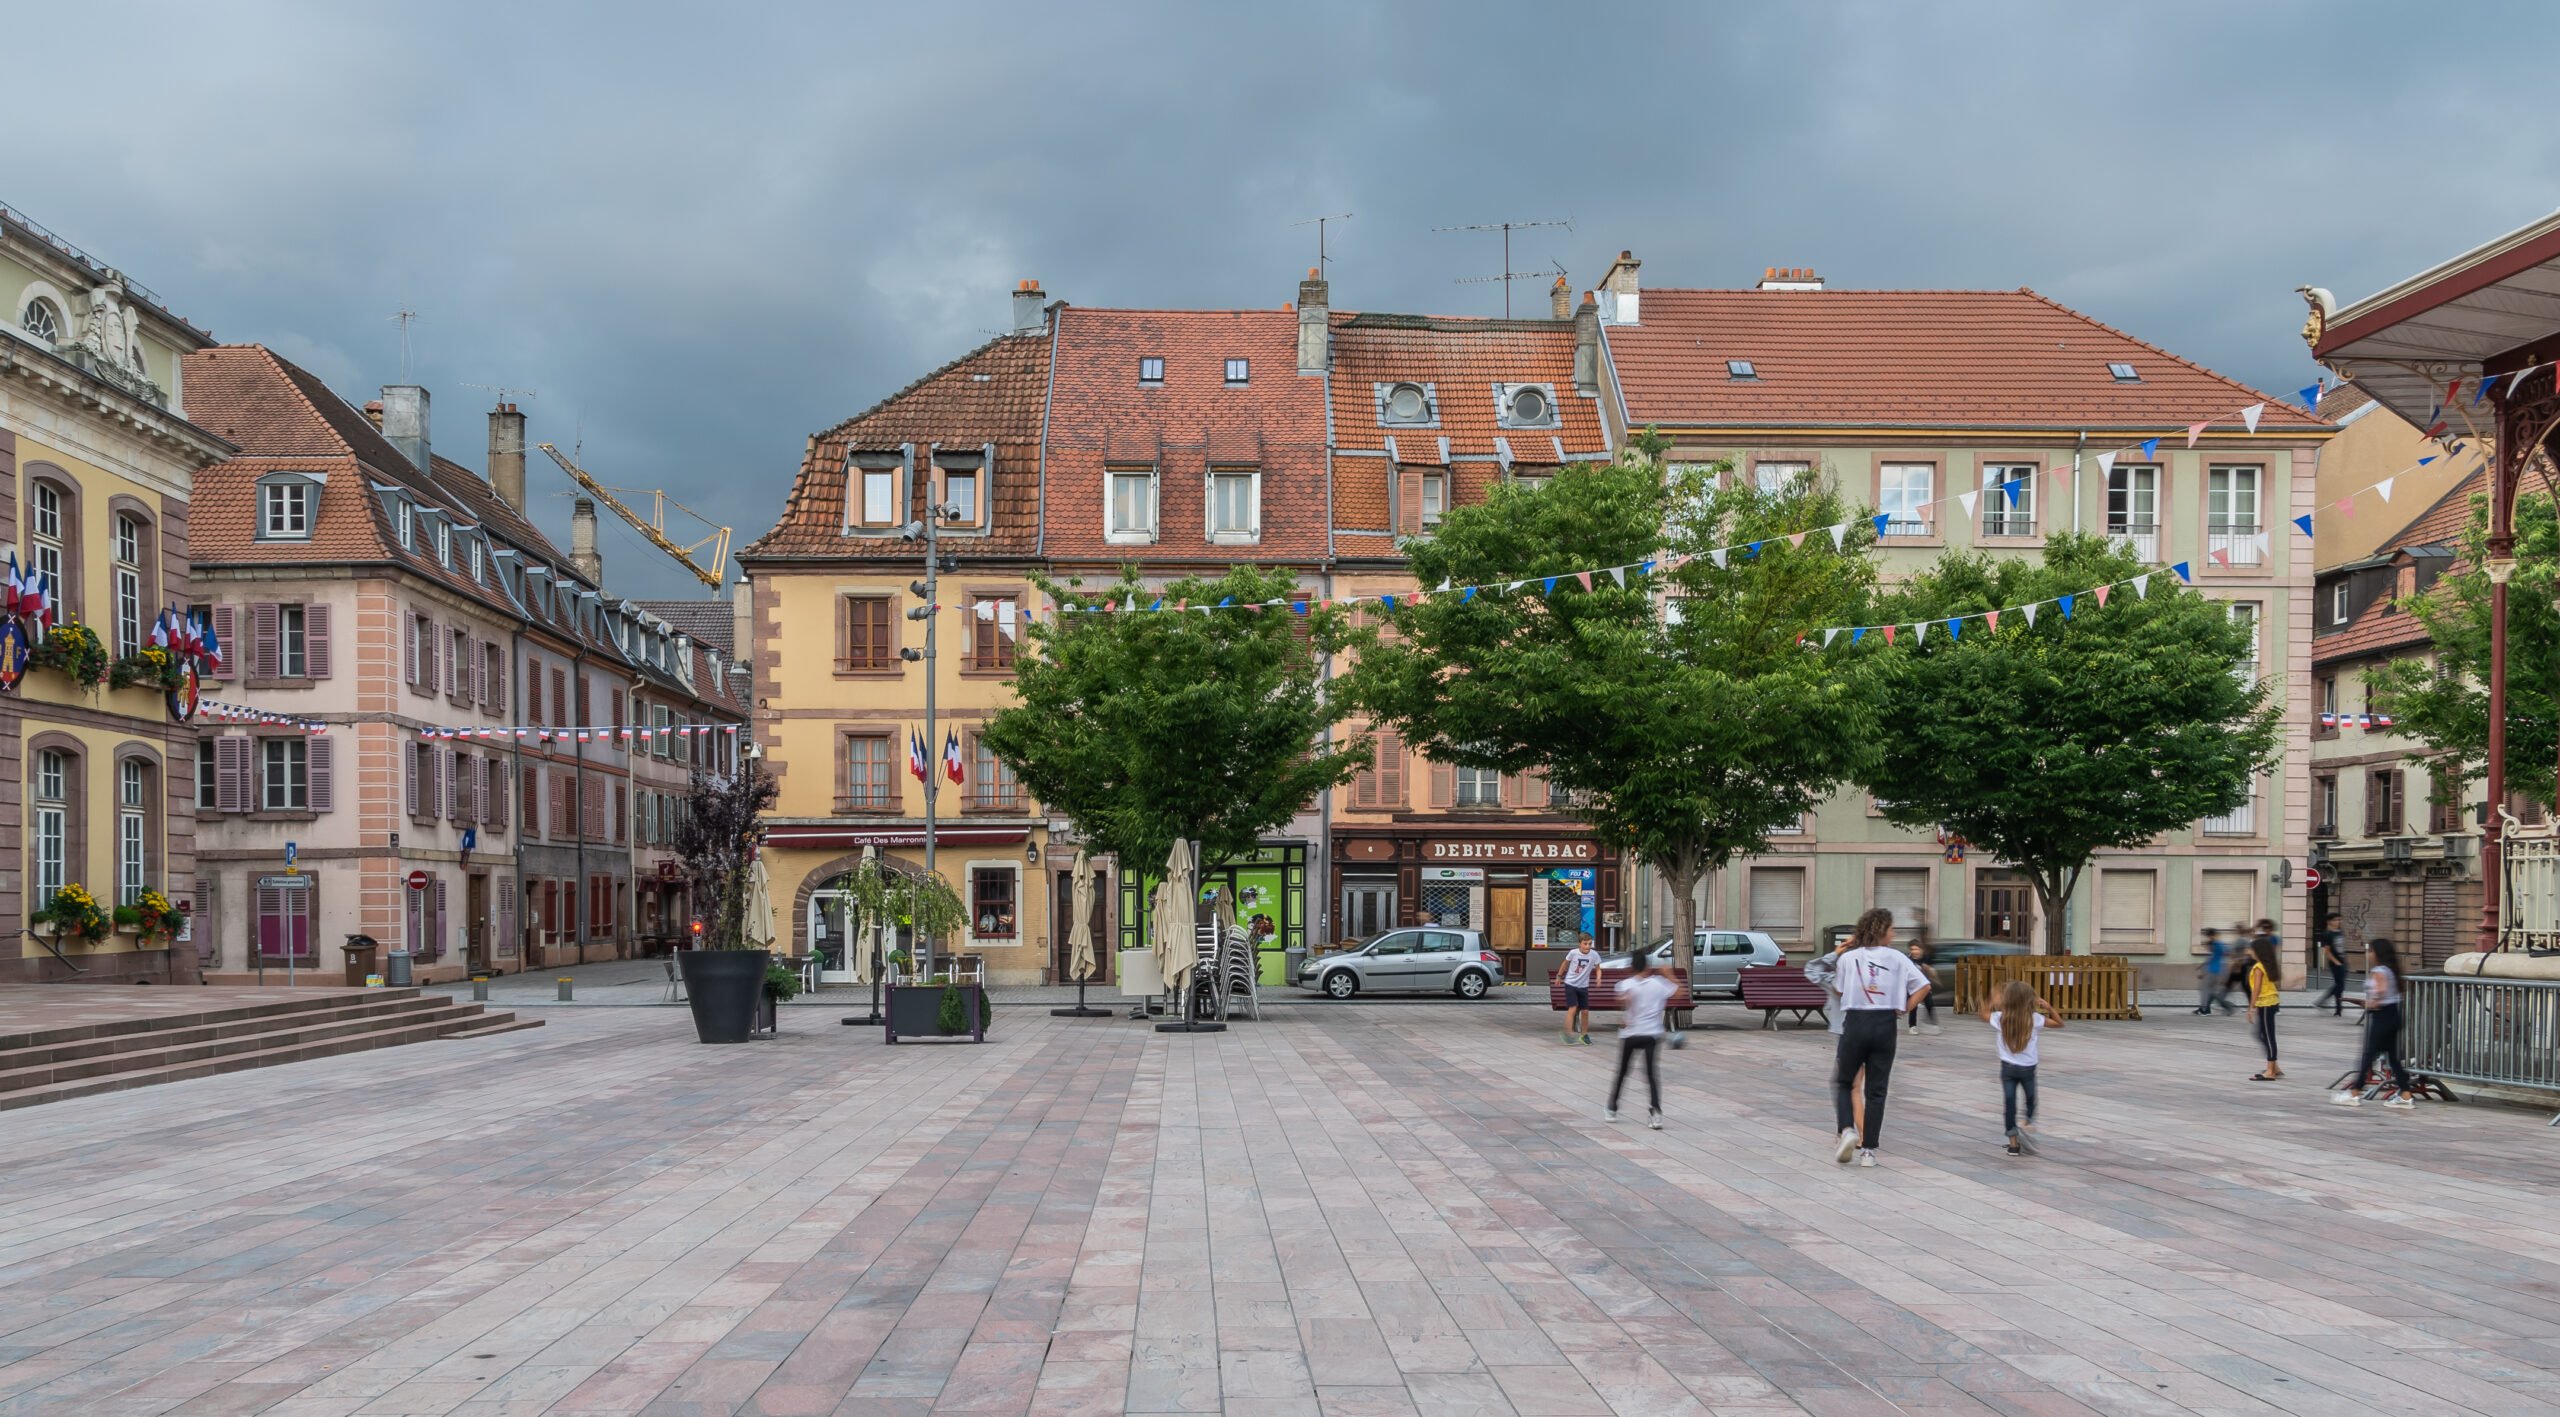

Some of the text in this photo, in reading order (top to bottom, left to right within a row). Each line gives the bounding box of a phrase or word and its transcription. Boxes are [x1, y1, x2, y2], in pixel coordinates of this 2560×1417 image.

[854, 836, 871, 844] Café
[890, 836, 938, 844] Marronnis
[288, 846, 294, 861] P
[1434, 843, 1587, 858] DEBIT DE TABAC
[1574, 958, 1590, 974] F
